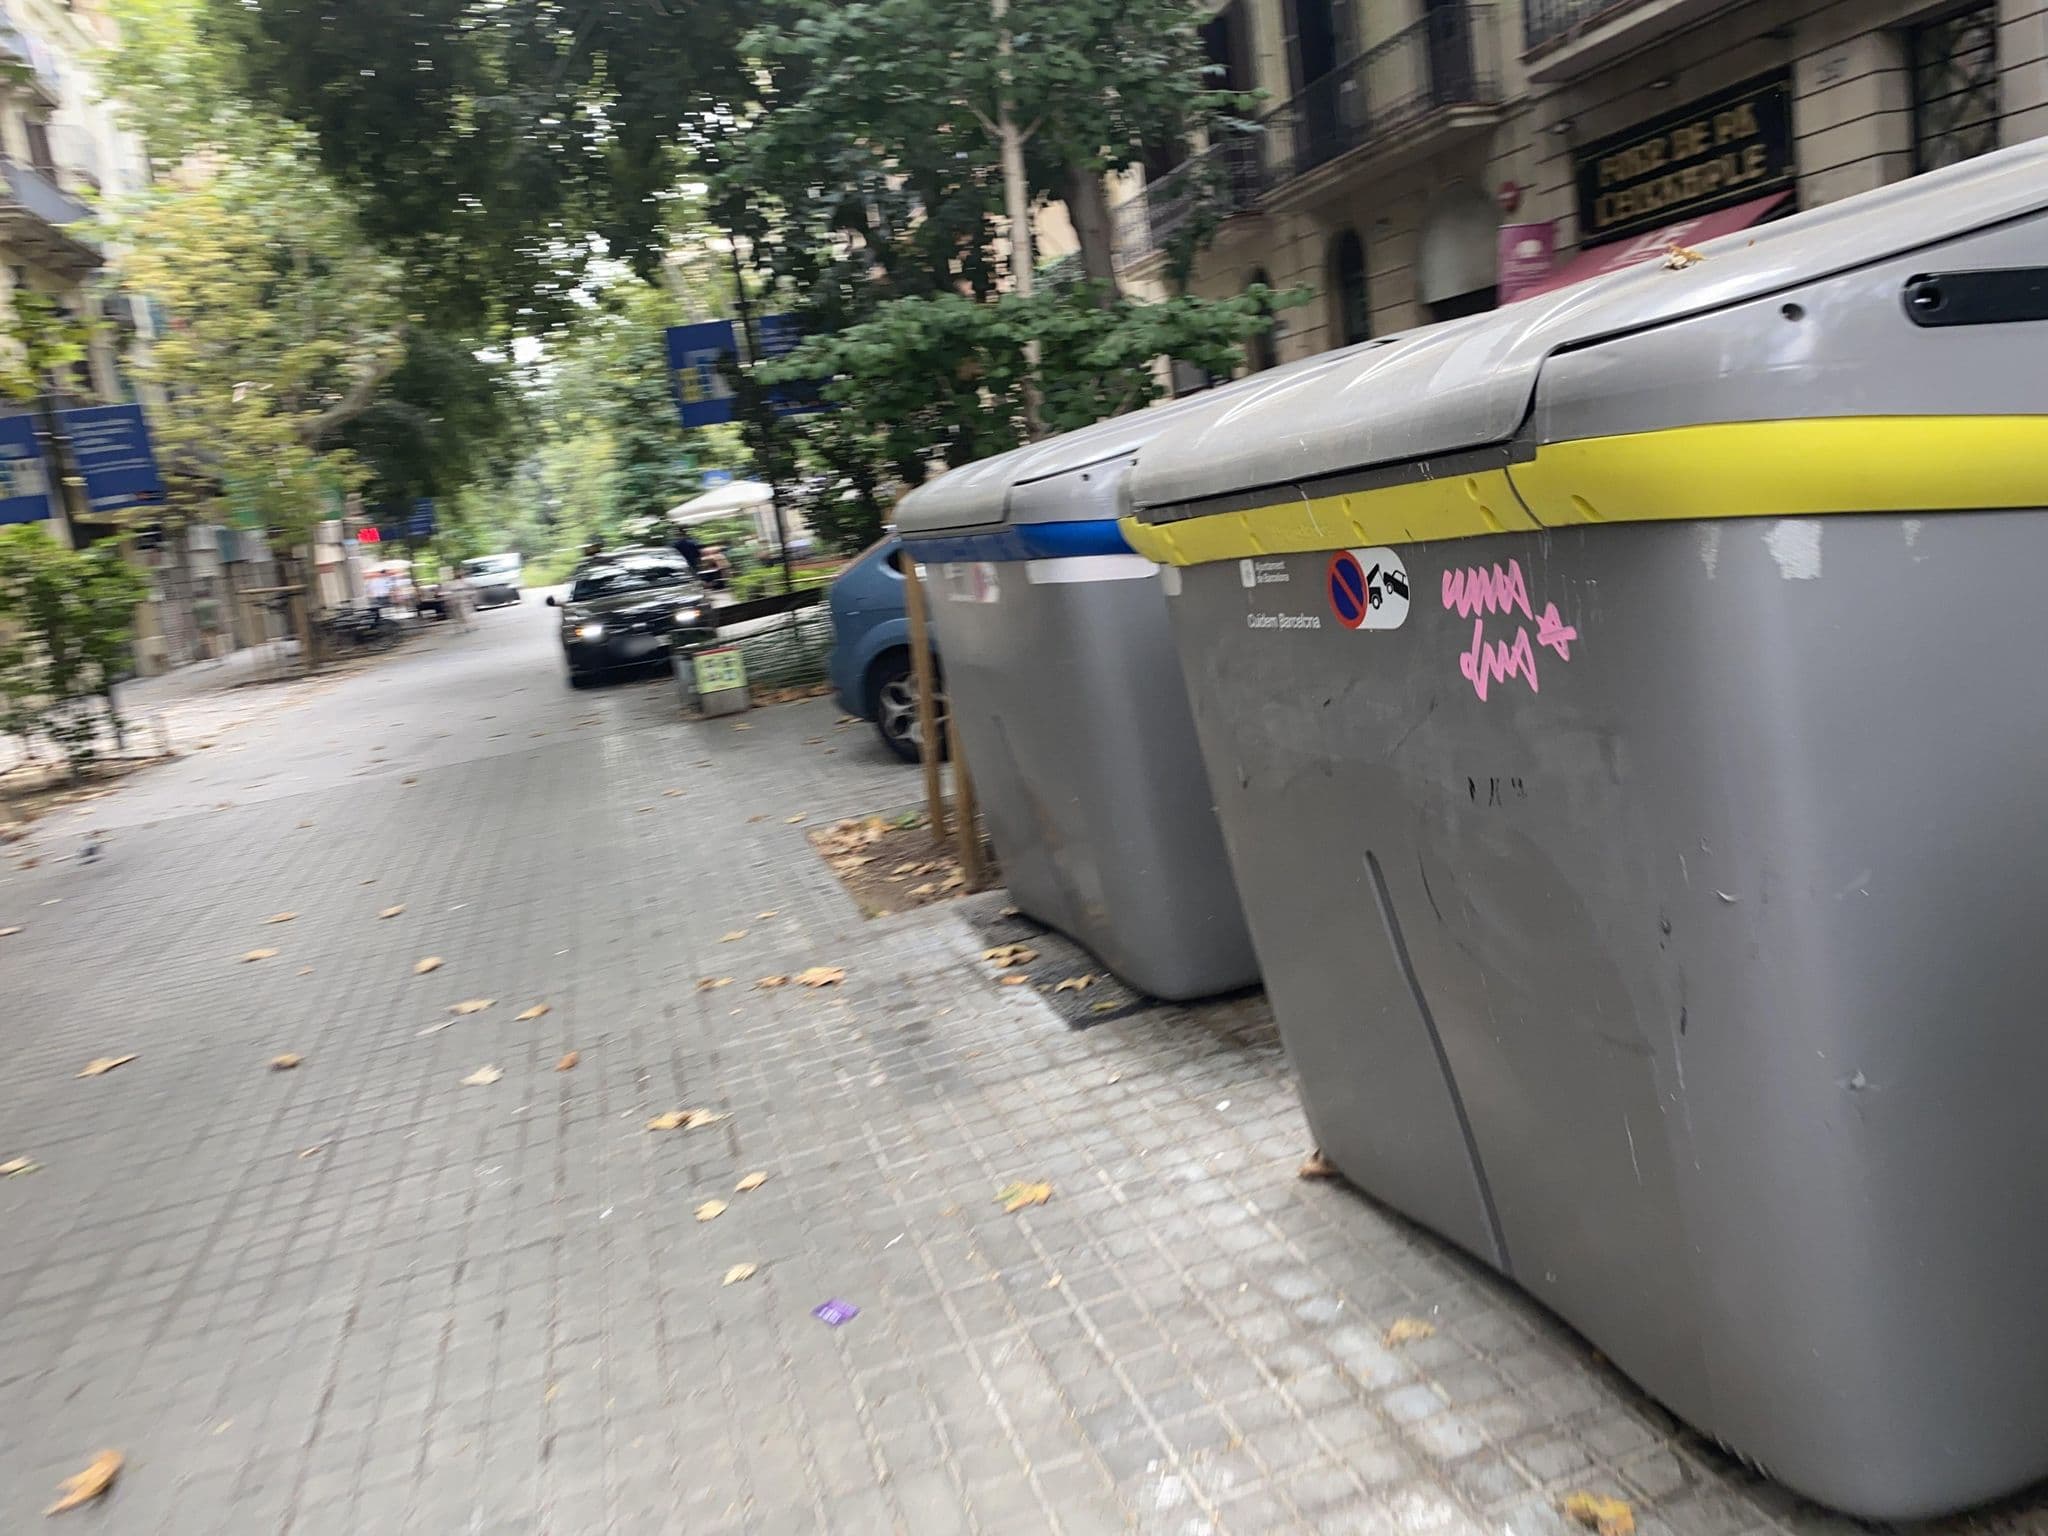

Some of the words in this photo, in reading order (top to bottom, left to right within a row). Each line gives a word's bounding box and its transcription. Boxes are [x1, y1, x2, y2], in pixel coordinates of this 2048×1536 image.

[1672, 122, 1711, 155] DE
[1247, 613, 1278, 628] Cuidem
[1278, 613, 1321, 628] Barcelona
